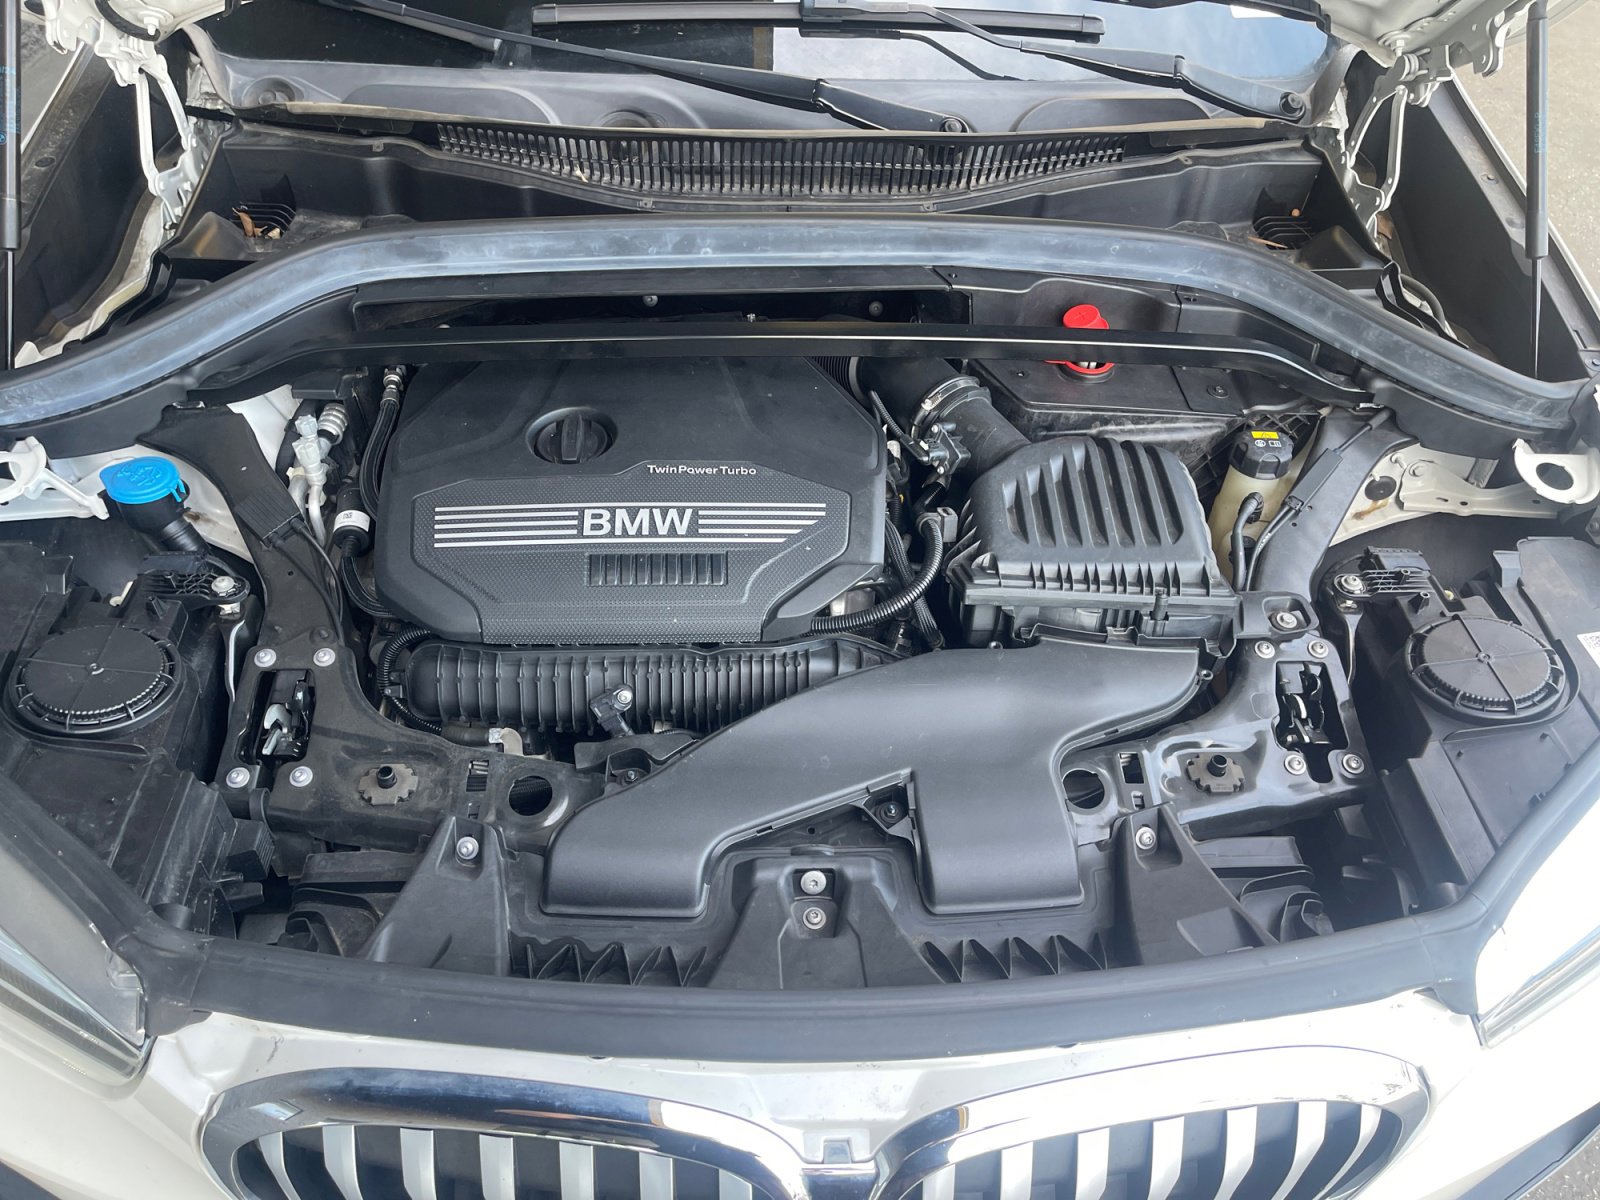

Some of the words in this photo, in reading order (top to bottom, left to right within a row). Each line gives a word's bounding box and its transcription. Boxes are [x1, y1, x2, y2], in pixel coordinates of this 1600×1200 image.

[647, 464, 719, 475] TwinPower
[719, 465, 757, 475] Turbo
[582, 508, 693, 536] BMW
